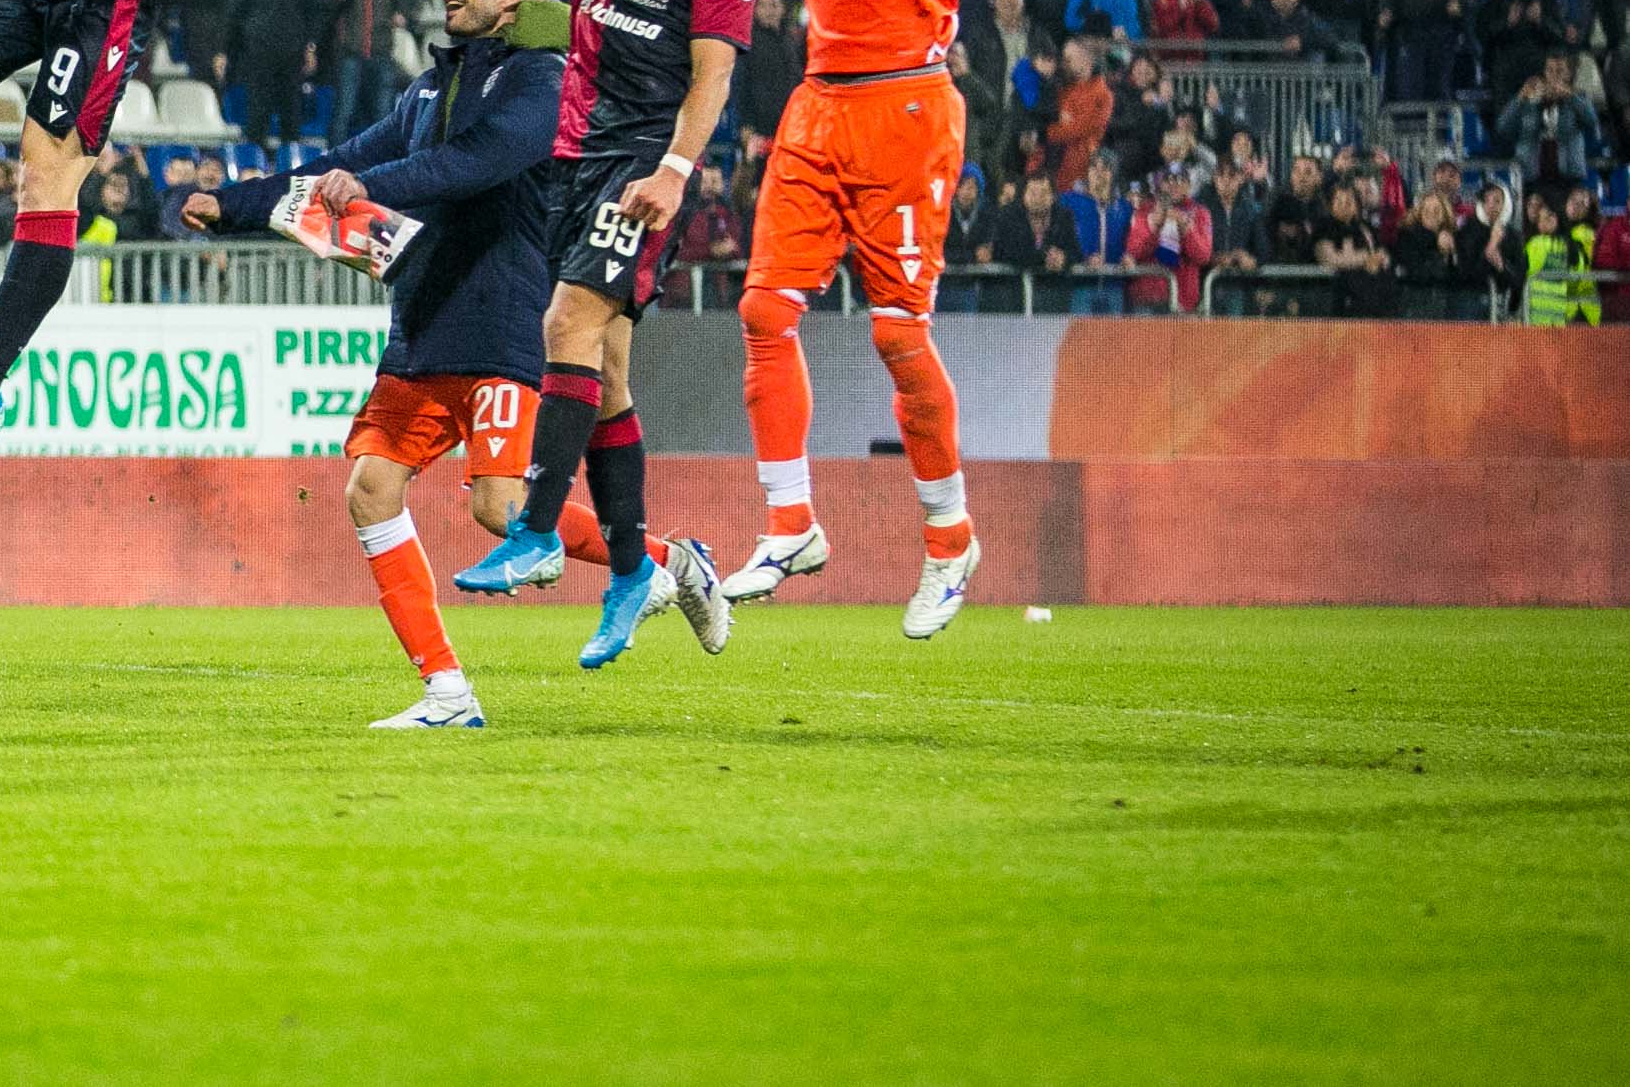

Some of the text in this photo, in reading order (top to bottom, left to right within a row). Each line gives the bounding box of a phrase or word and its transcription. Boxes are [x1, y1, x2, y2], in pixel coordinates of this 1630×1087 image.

[47, 46, 80, 96] 9
[589, 201, 645, 257] 99
[896, 205, 921, 255] 1
[473, 383, 519, 431] 20
